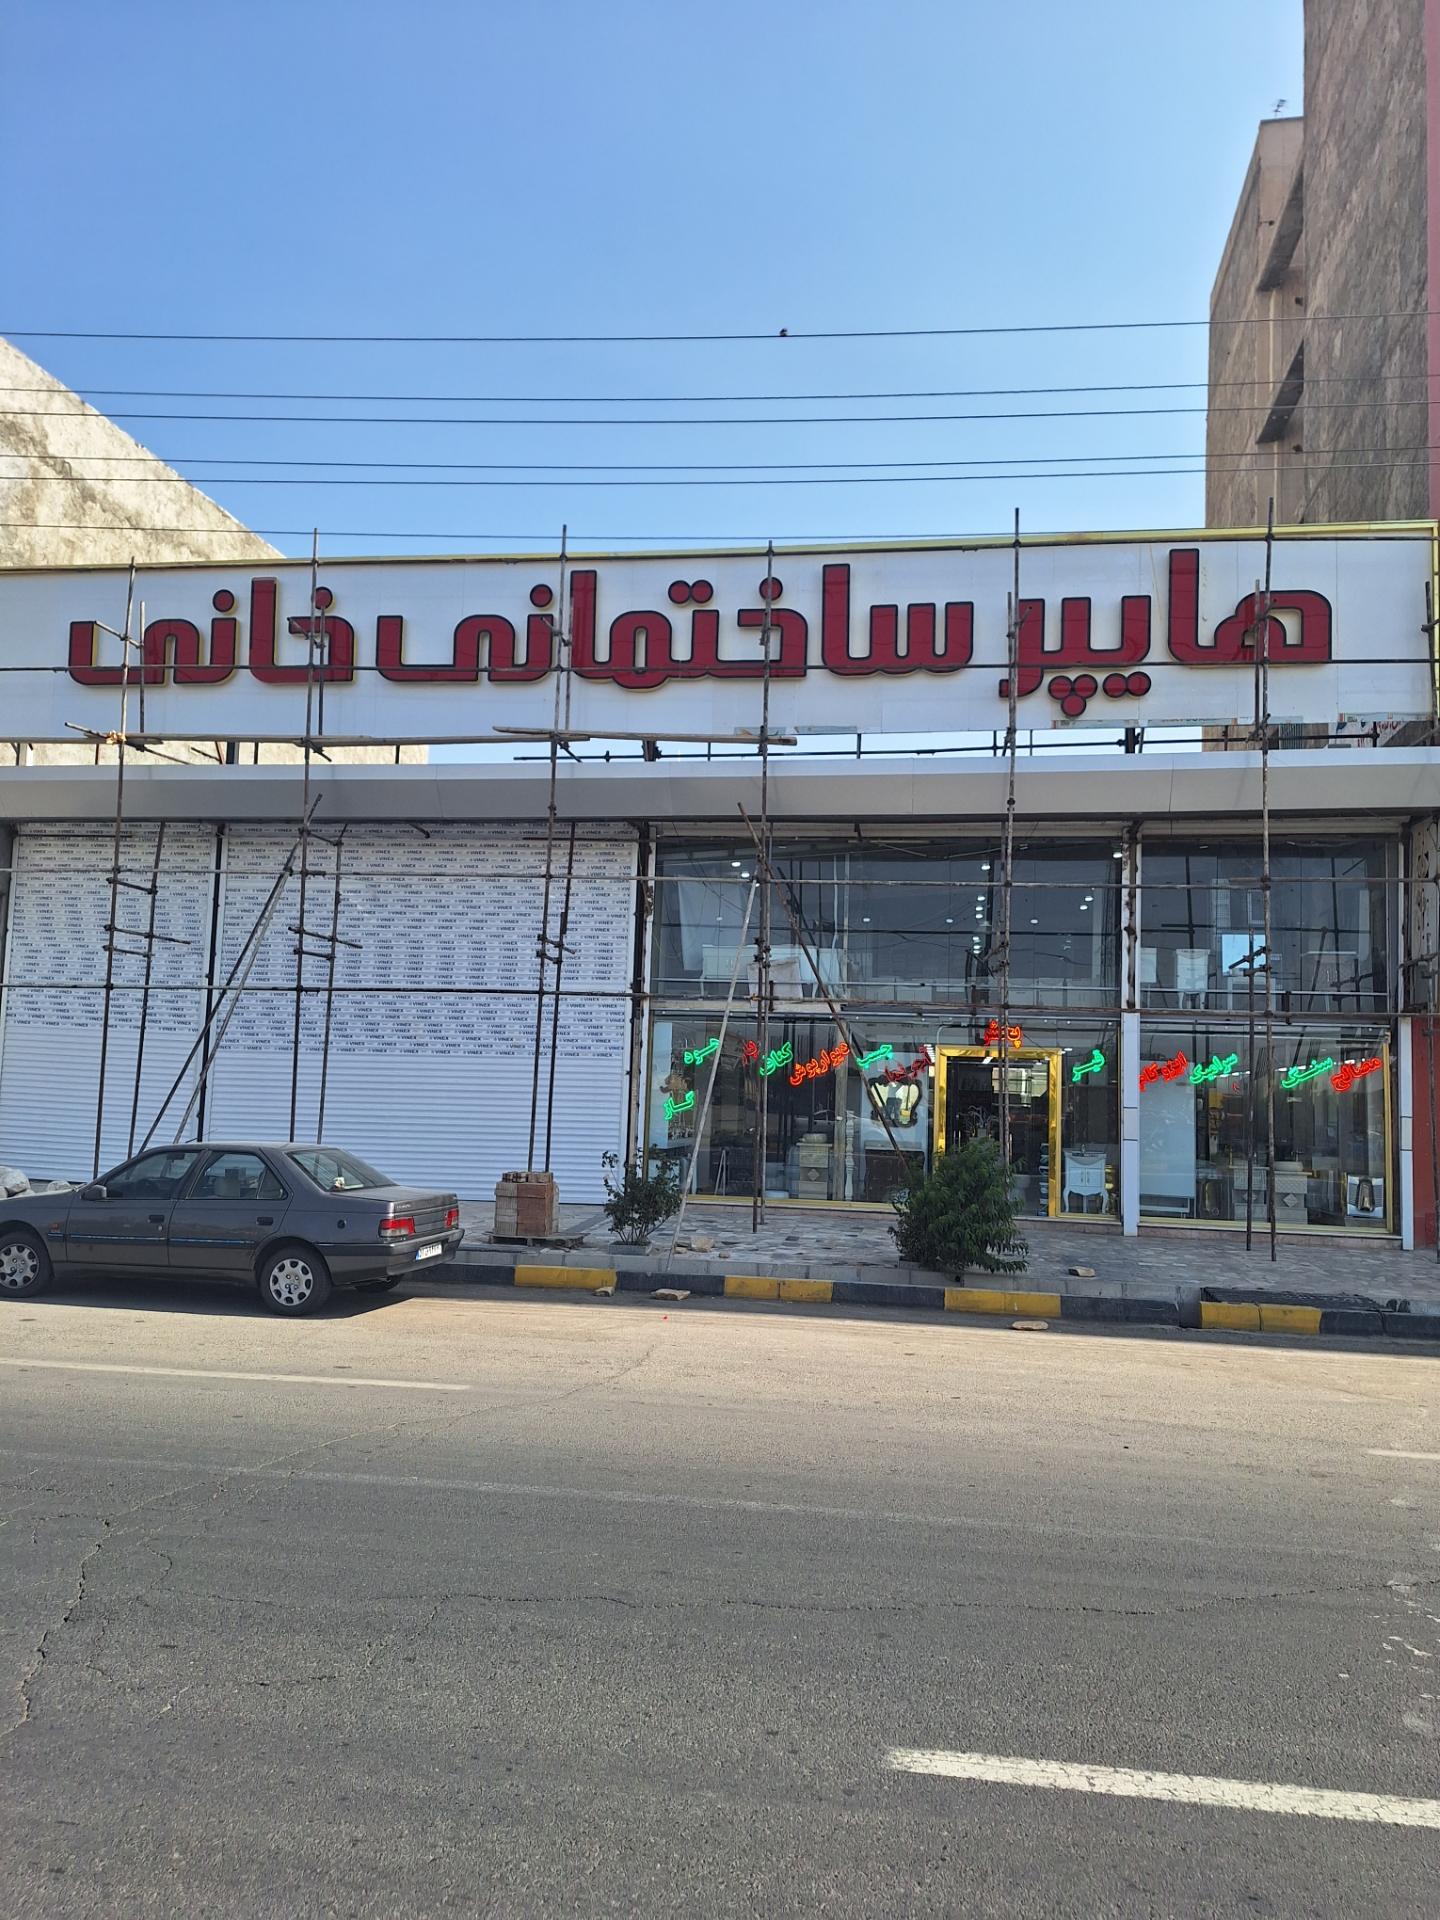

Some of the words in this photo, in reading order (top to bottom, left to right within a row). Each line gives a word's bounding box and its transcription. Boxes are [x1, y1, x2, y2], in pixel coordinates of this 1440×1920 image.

[68, 577, 355, 686] خانی
[375, 563, 974, 690] ساختمانی
[999, 548, 1332, 717] هایپر
[1189, 1053, 1238, 1084] سرامیک
[1281, 1057, 1333, 1089] سنگ
[1331, 1057, 1383, 1092] مصالح
